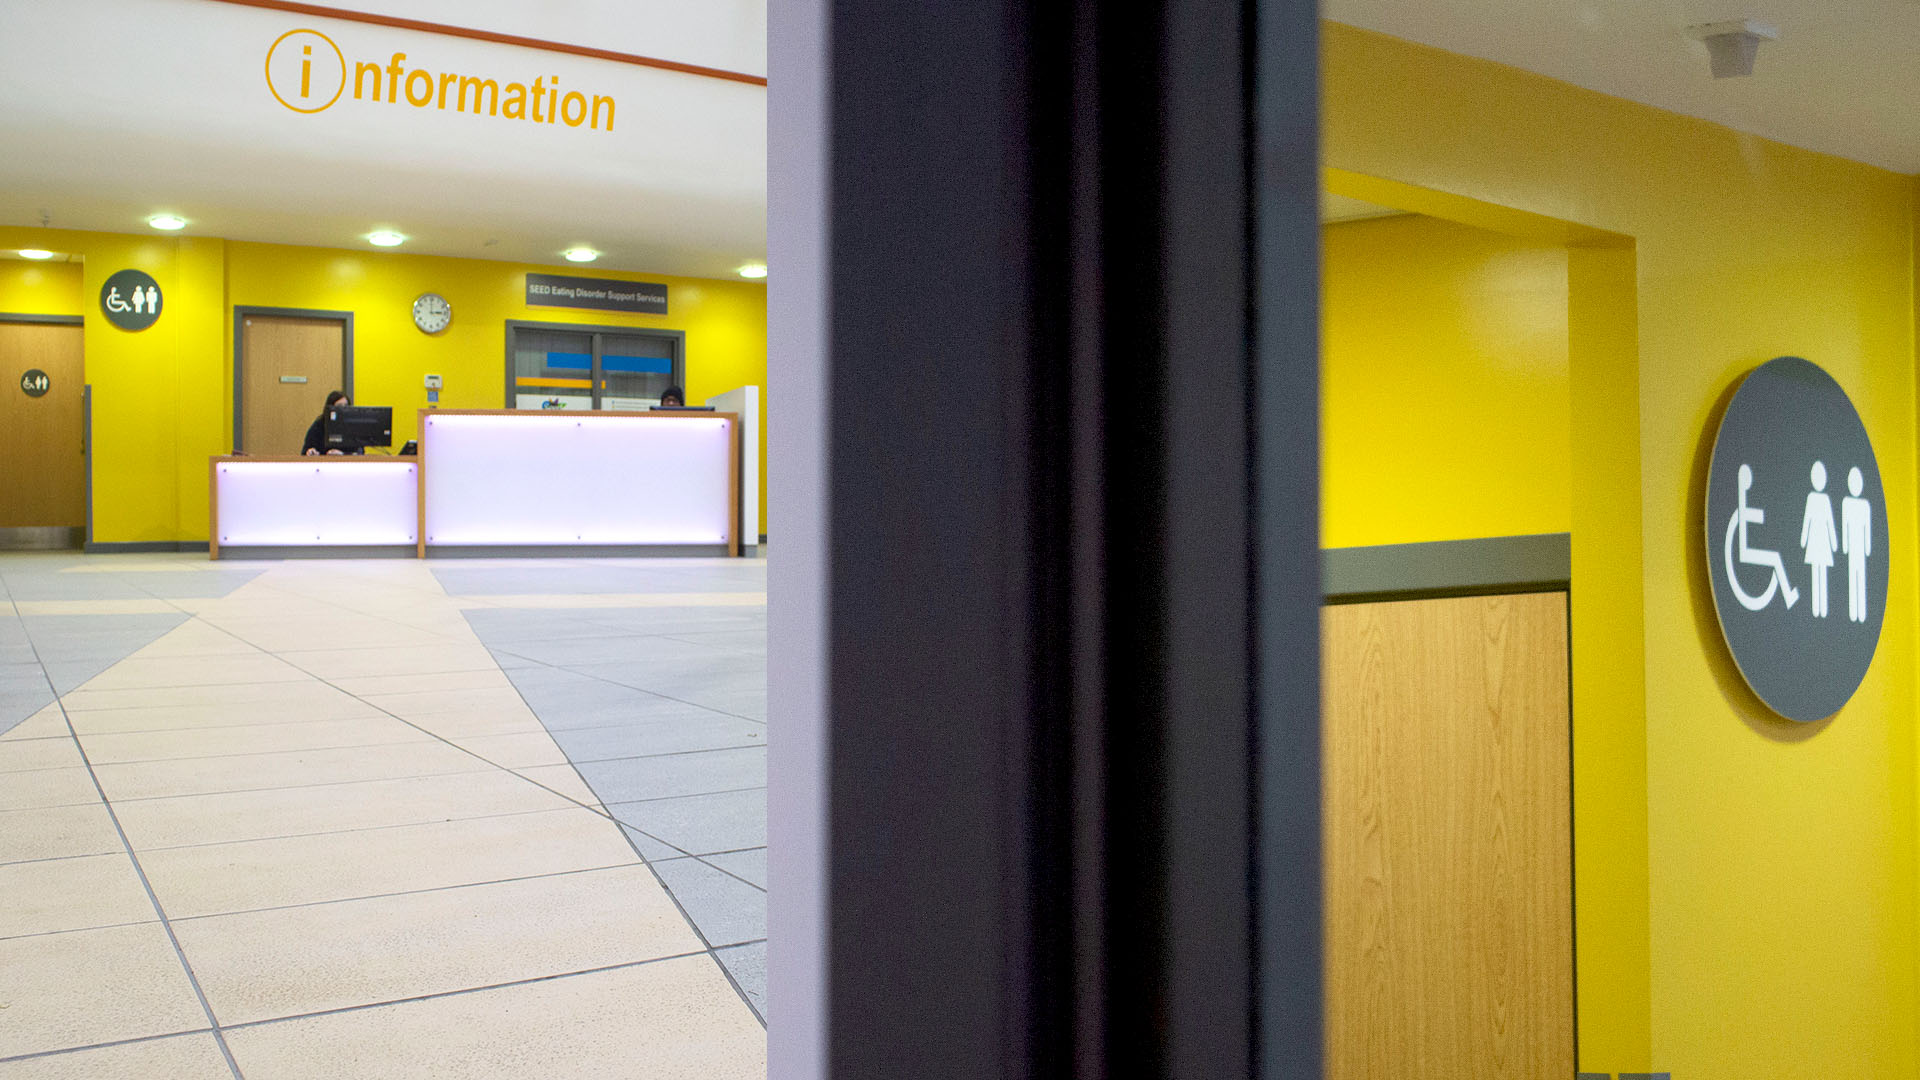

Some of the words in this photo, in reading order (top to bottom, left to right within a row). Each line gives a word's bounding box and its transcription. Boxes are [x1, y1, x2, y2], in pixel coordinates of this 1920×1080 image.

[529, 284, 550, 294] SEED
[552, 286, 575, 298] Eating
[576, 288, 607, 299] Disorder
[607, 290, 635, 301] Support
[636, 292, 665, 303] Services
